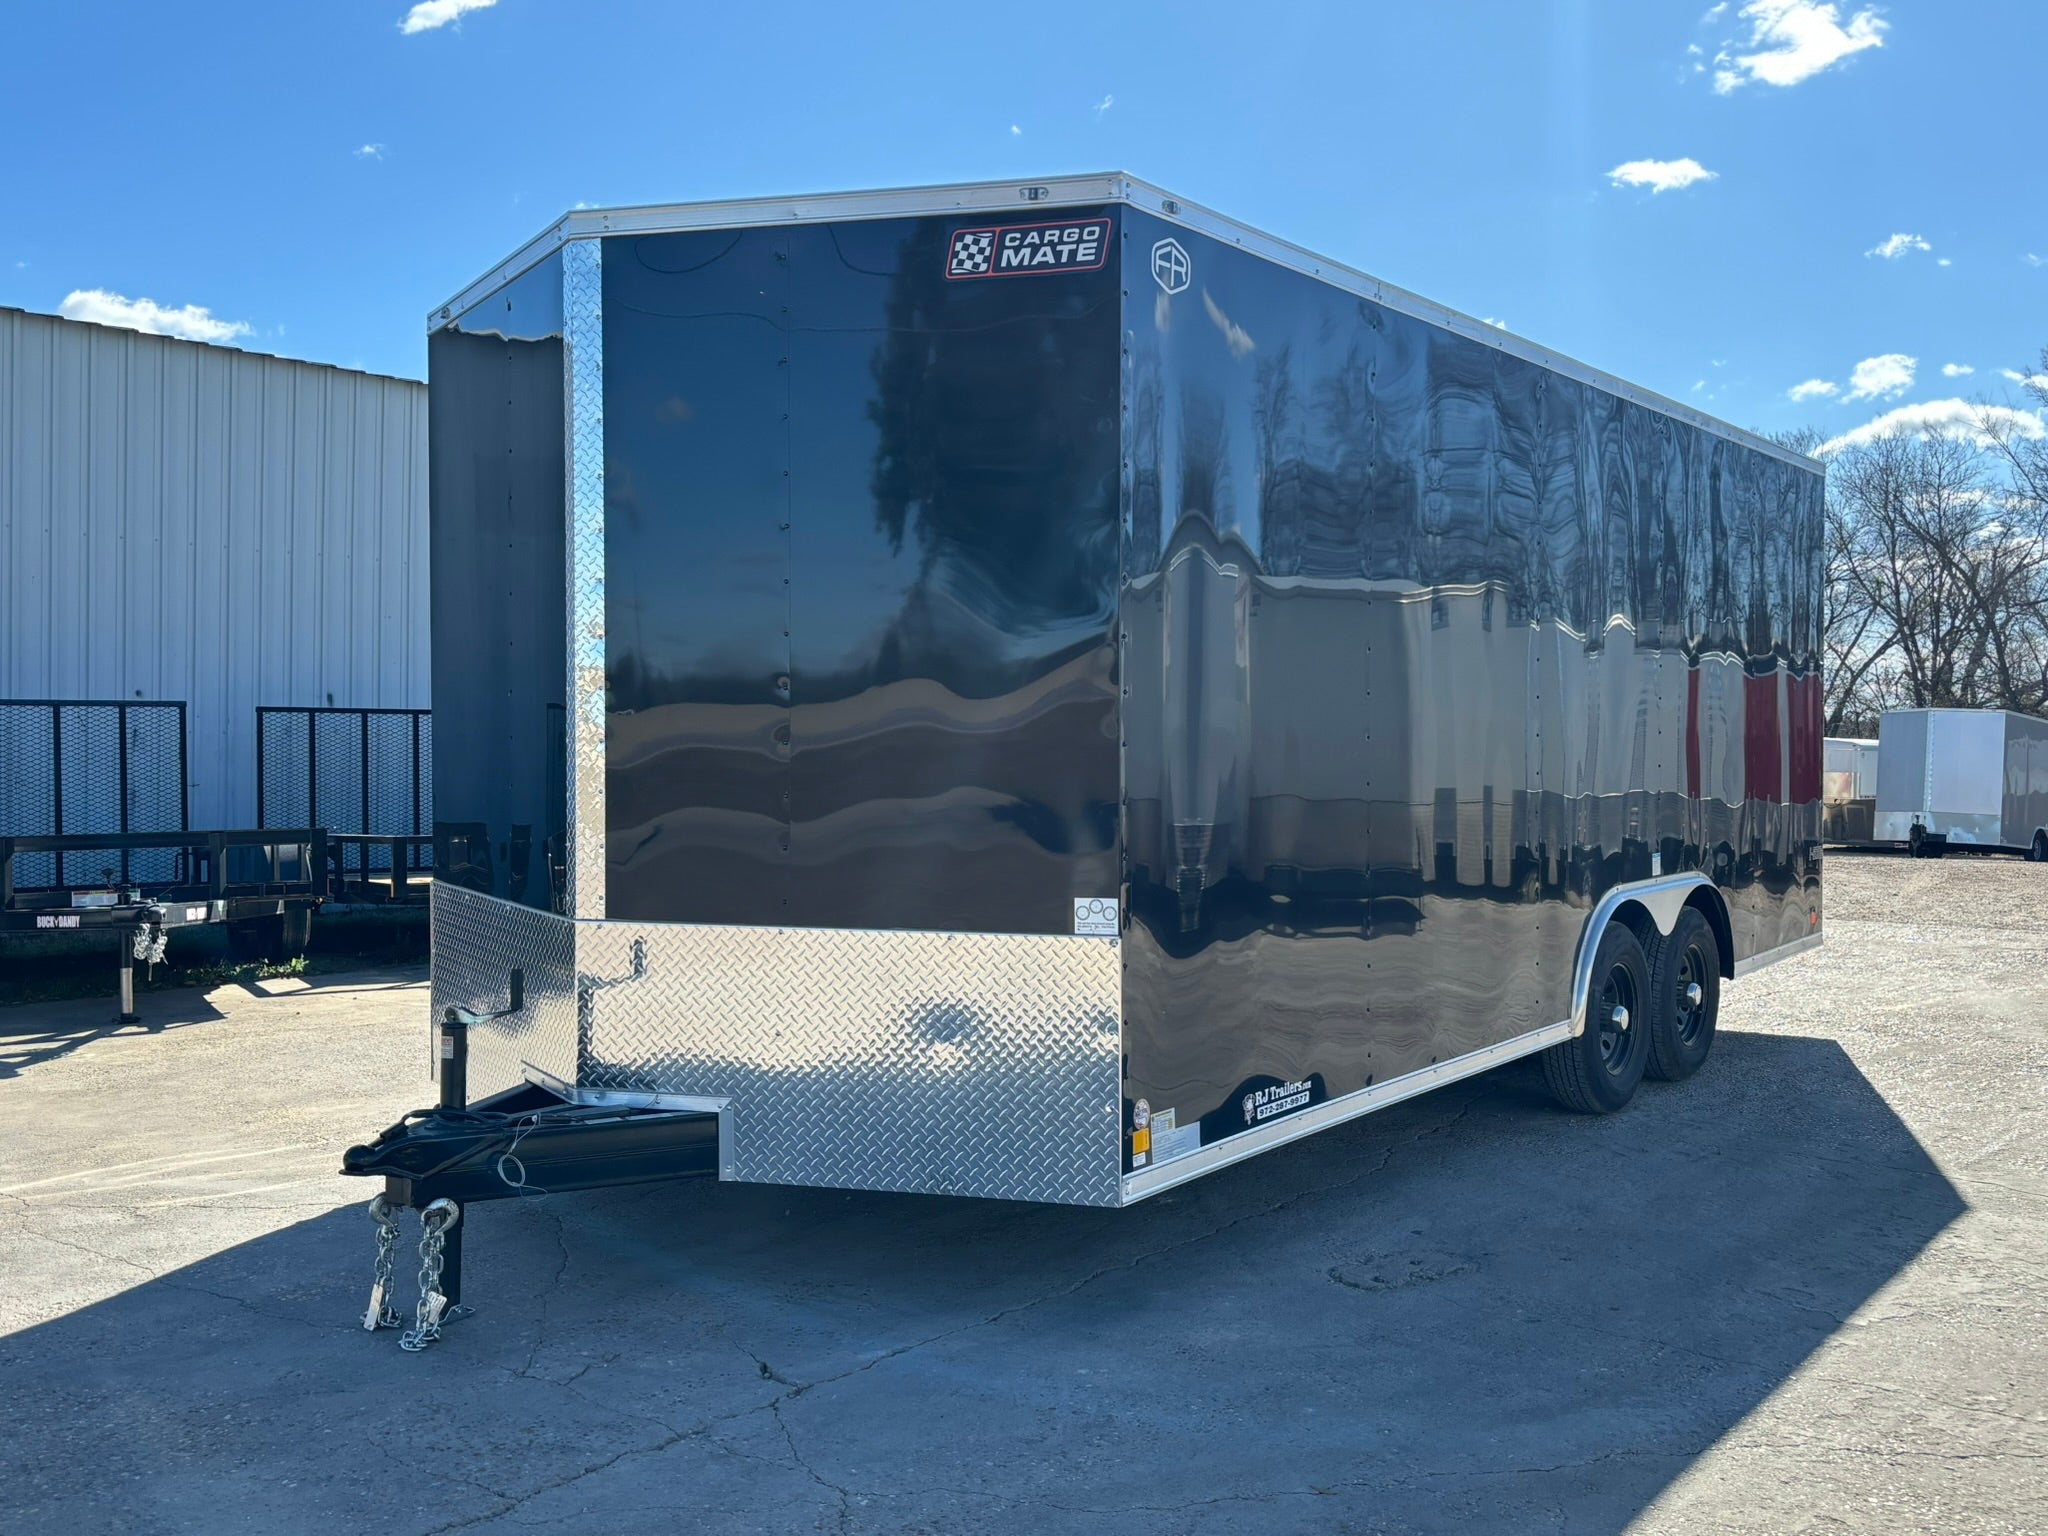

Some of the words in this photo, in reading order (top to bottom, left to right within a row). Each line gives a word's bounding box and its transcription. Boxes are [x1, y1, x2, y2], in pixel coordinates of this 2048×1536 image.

[1004, 226, 1100, 247] CARGO
[1000, 242, 1098, 267] MATE
[36, 915, 55, 928] BUCK
[58, 915, 80, 928] DANDY
[1254, 1088, 1269, 1106] RJ
[1258, 1093, 1308, 1117] 972-287-9977
